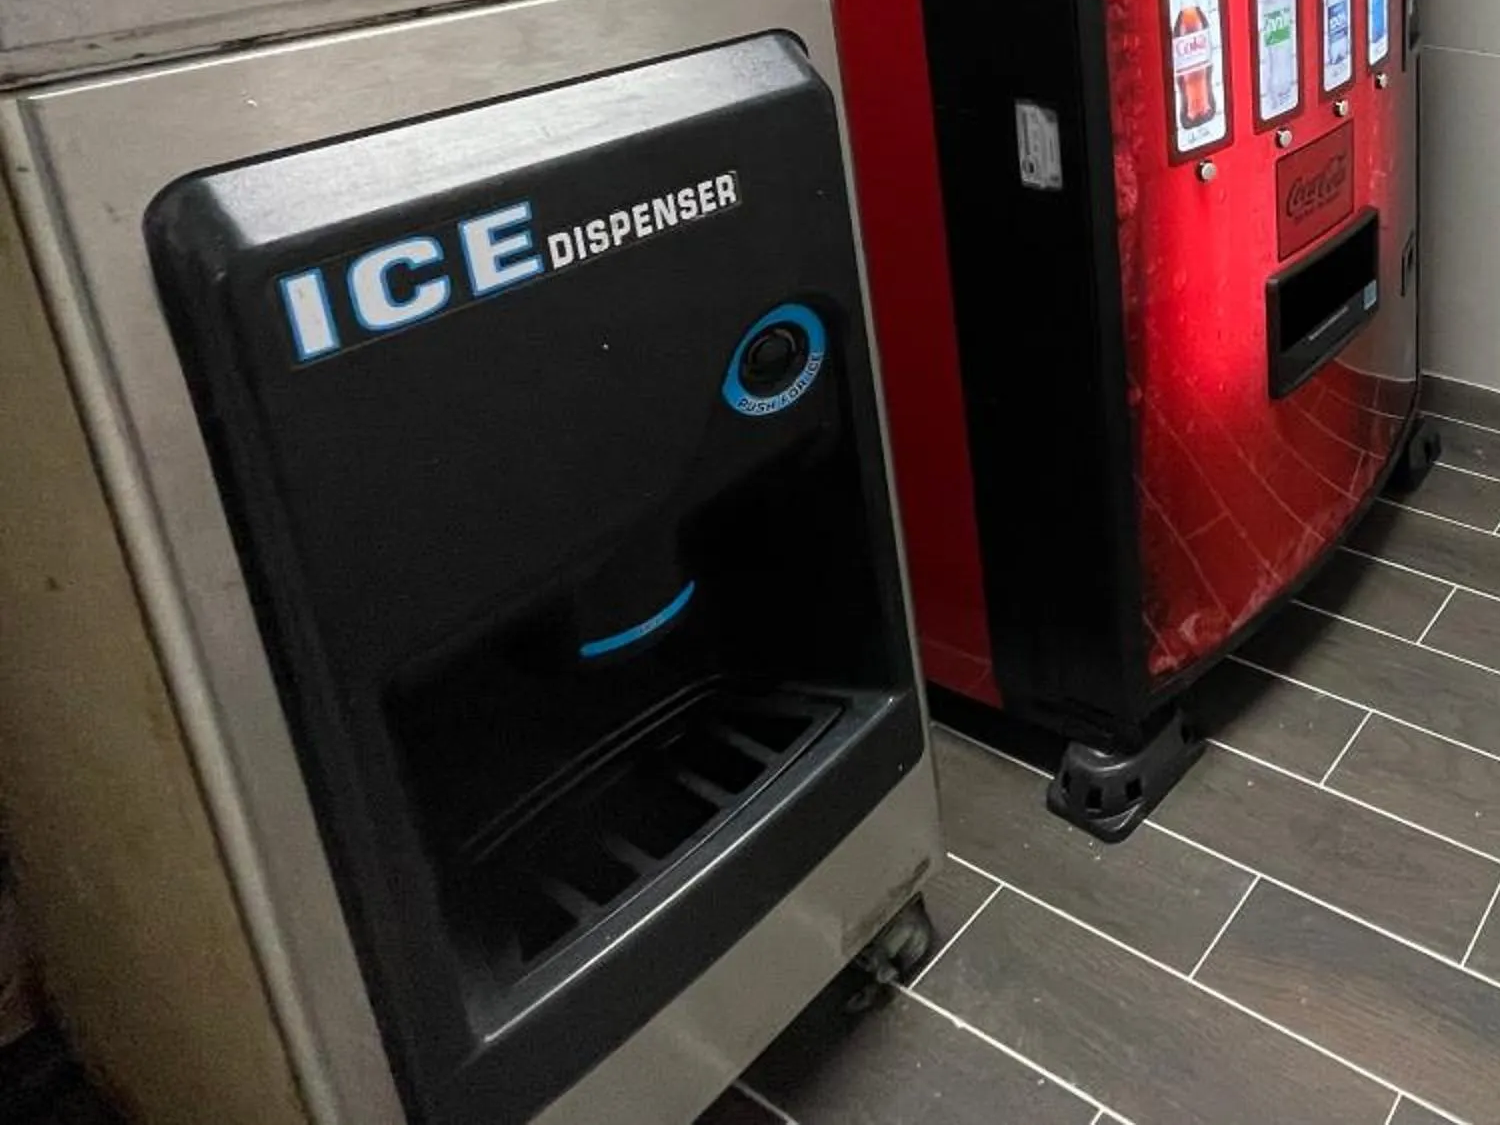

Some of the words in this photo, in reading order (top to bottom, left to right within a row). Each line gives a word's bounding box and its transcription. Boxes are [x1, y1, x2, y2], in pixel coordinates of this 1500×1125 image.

[280, 197, 544, 361] ICE
[547, 171, 739, 269] DISPENSER
[737, 396, 777, 412] PUSH
[780, 374, 811, 406] FOR
